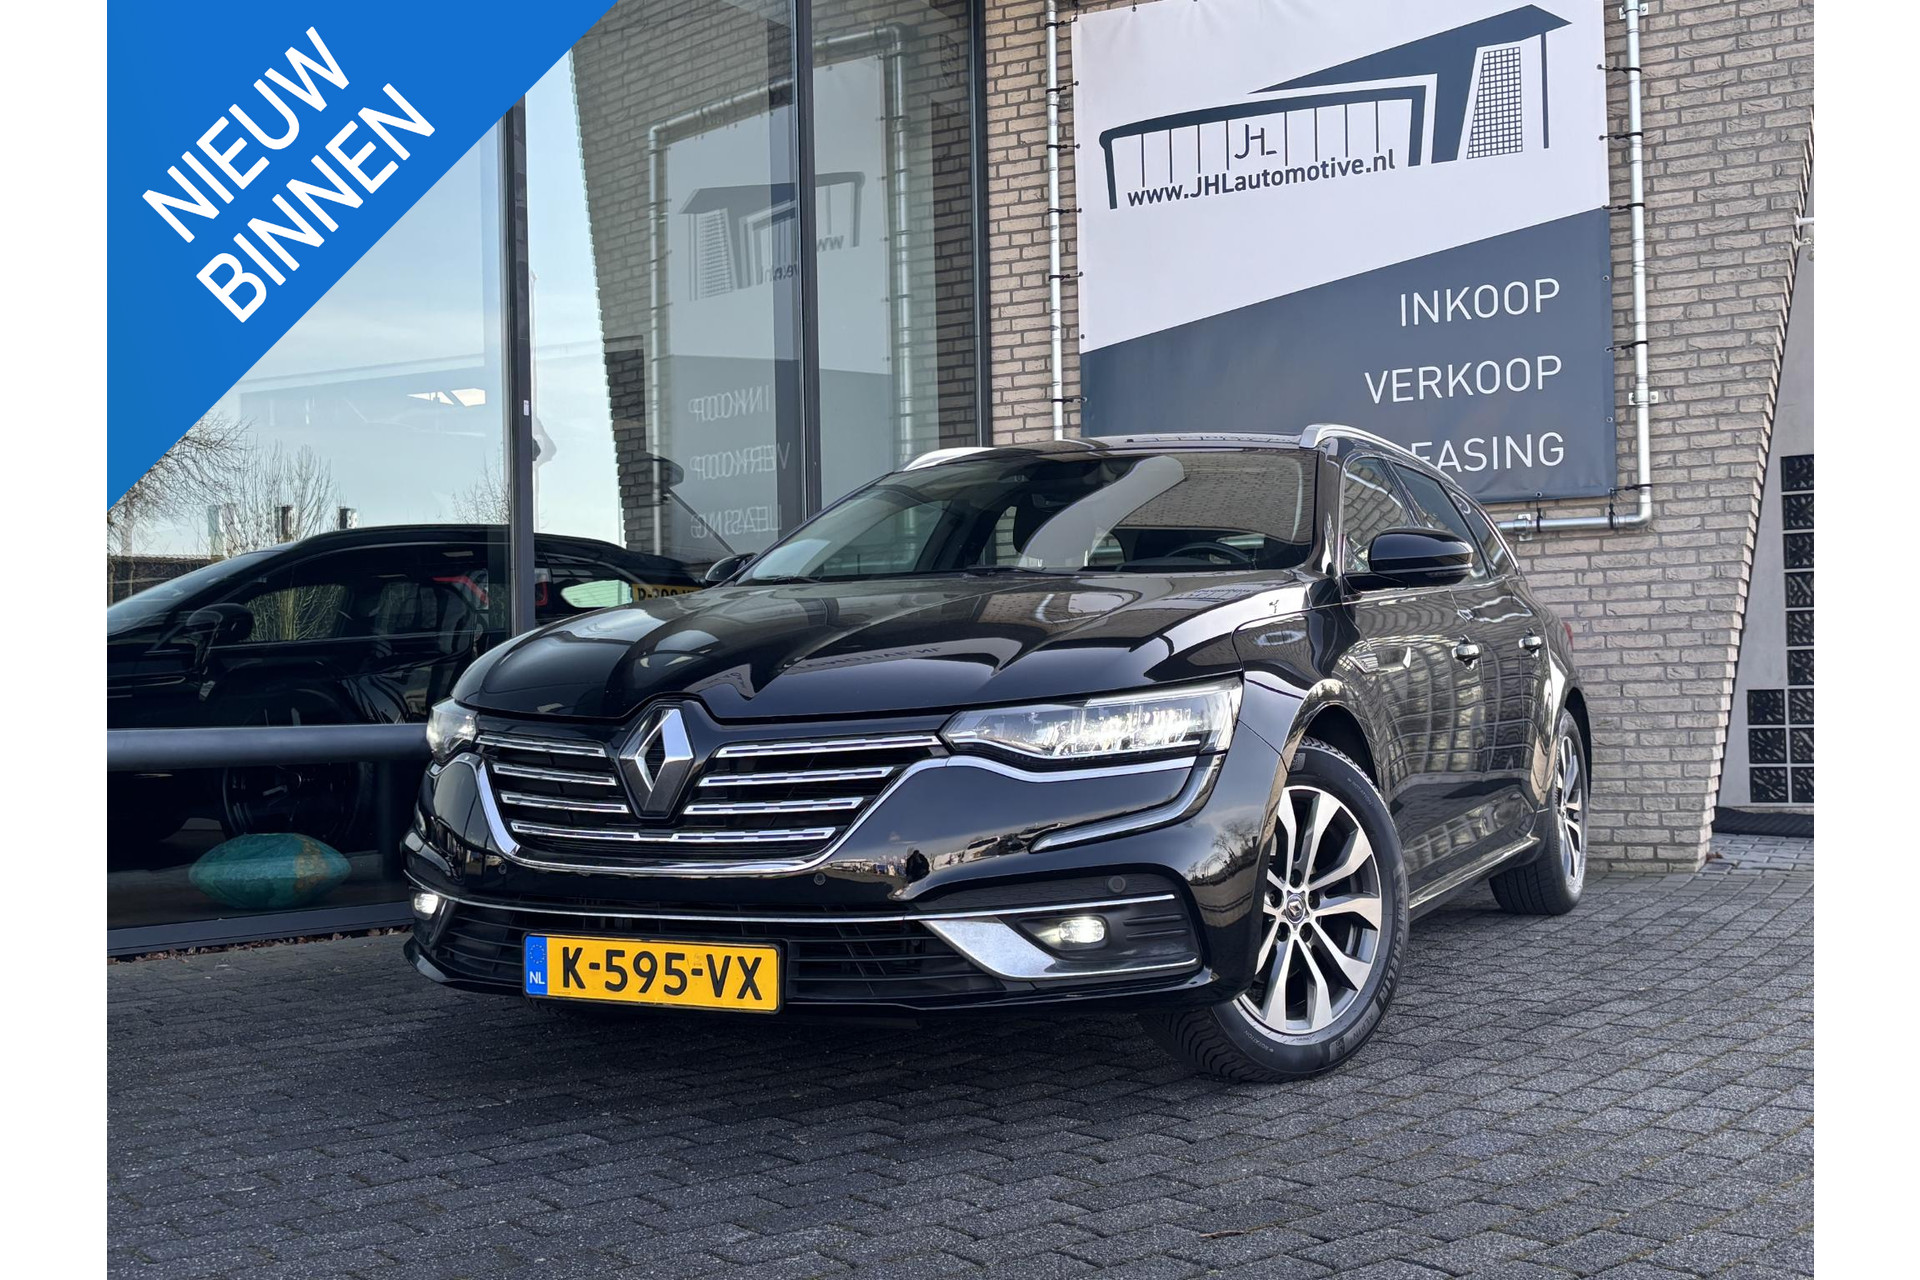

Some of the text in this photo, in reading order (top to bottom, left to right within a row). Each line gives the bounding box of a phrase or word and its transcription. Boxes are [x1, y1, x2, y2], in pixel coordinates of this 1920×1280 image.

[1127, 148, 1396, 206] www.JHLautomotive.nl
[1400, 277, 1560, 327] INKOOP
[1364, 355, 1563, 404] VERKOOP
[1411, 432, 1565, 473] EASING
[529, 971, 545, 985] NL
[561, 947, 763, 1000] K-595-VX
